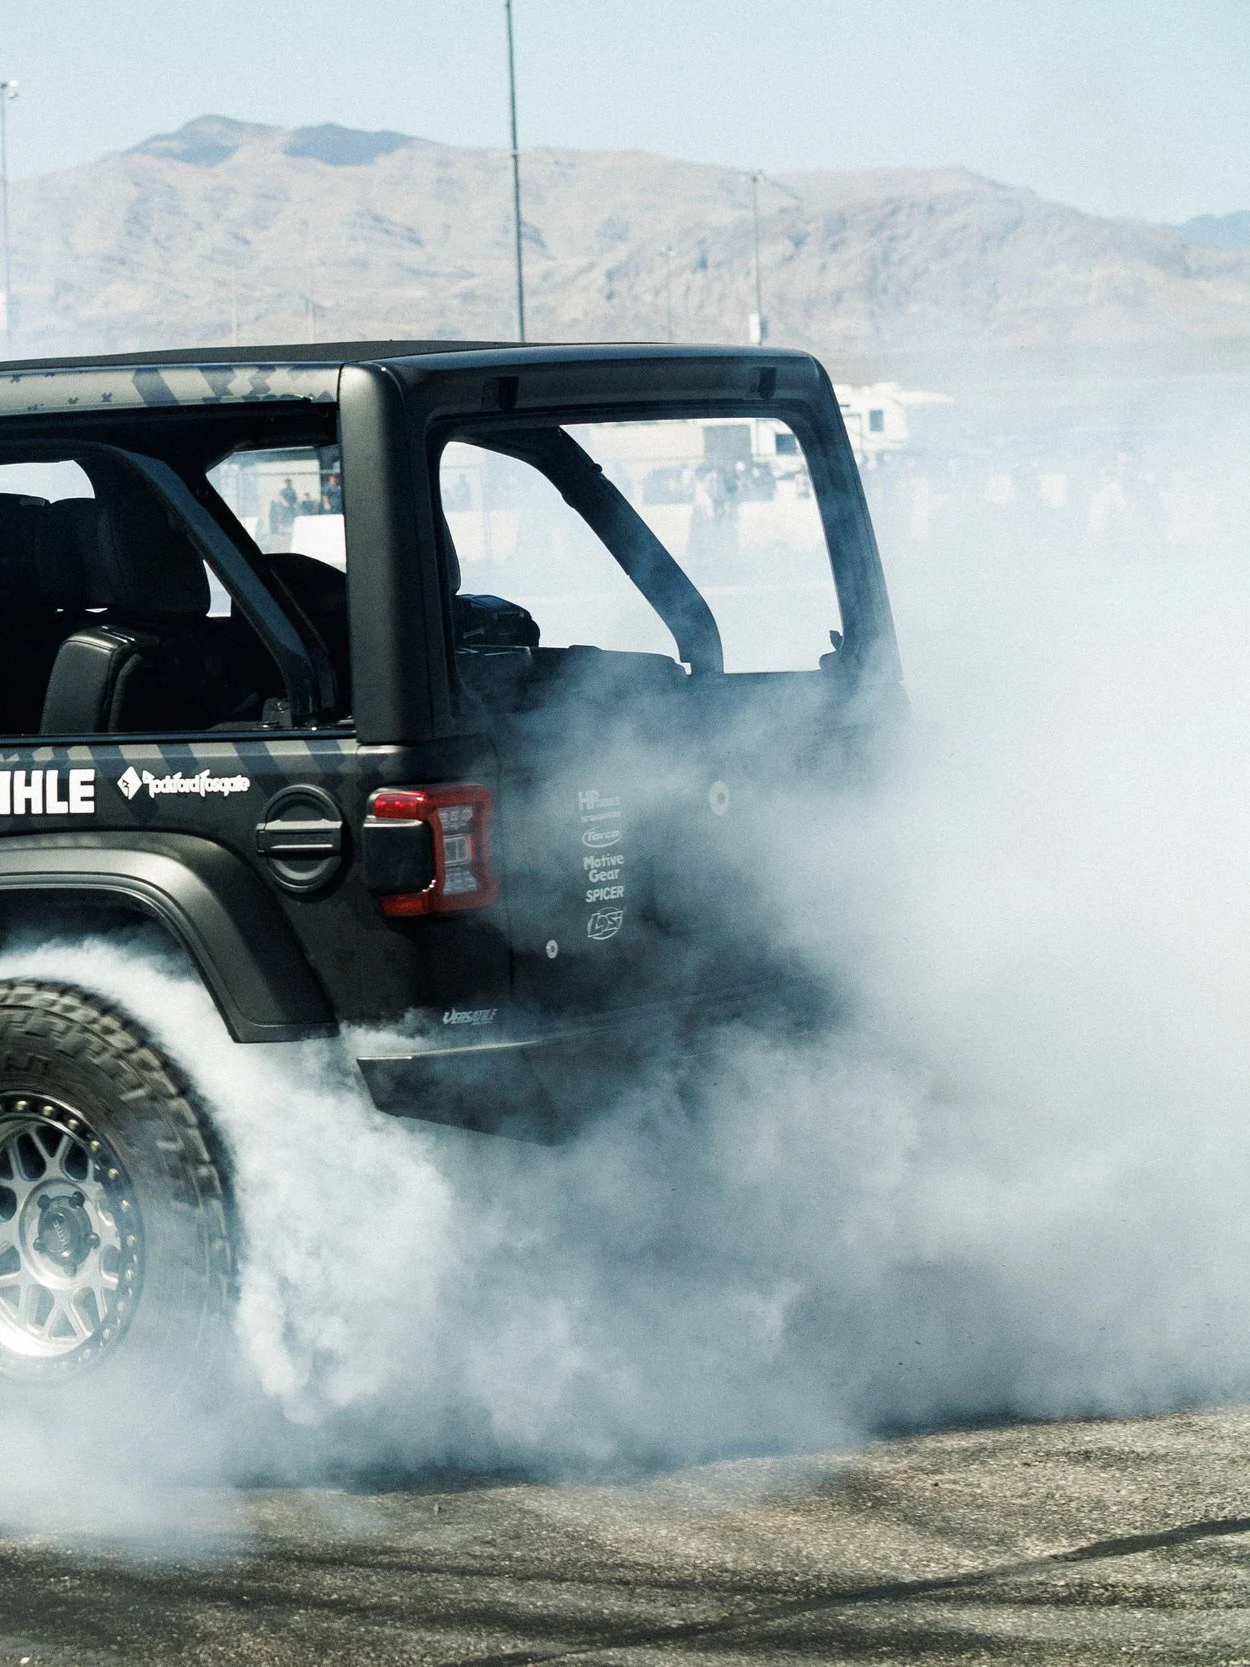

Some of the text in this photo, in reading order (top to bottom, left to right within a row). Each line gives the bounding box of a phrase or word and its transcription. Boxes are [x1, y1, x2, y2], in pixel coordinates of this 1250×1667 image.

[583, 853, 624, 870] Motive
[588, 869, 620, 883] Gear
[585, 885, 625, 903] SPICER
